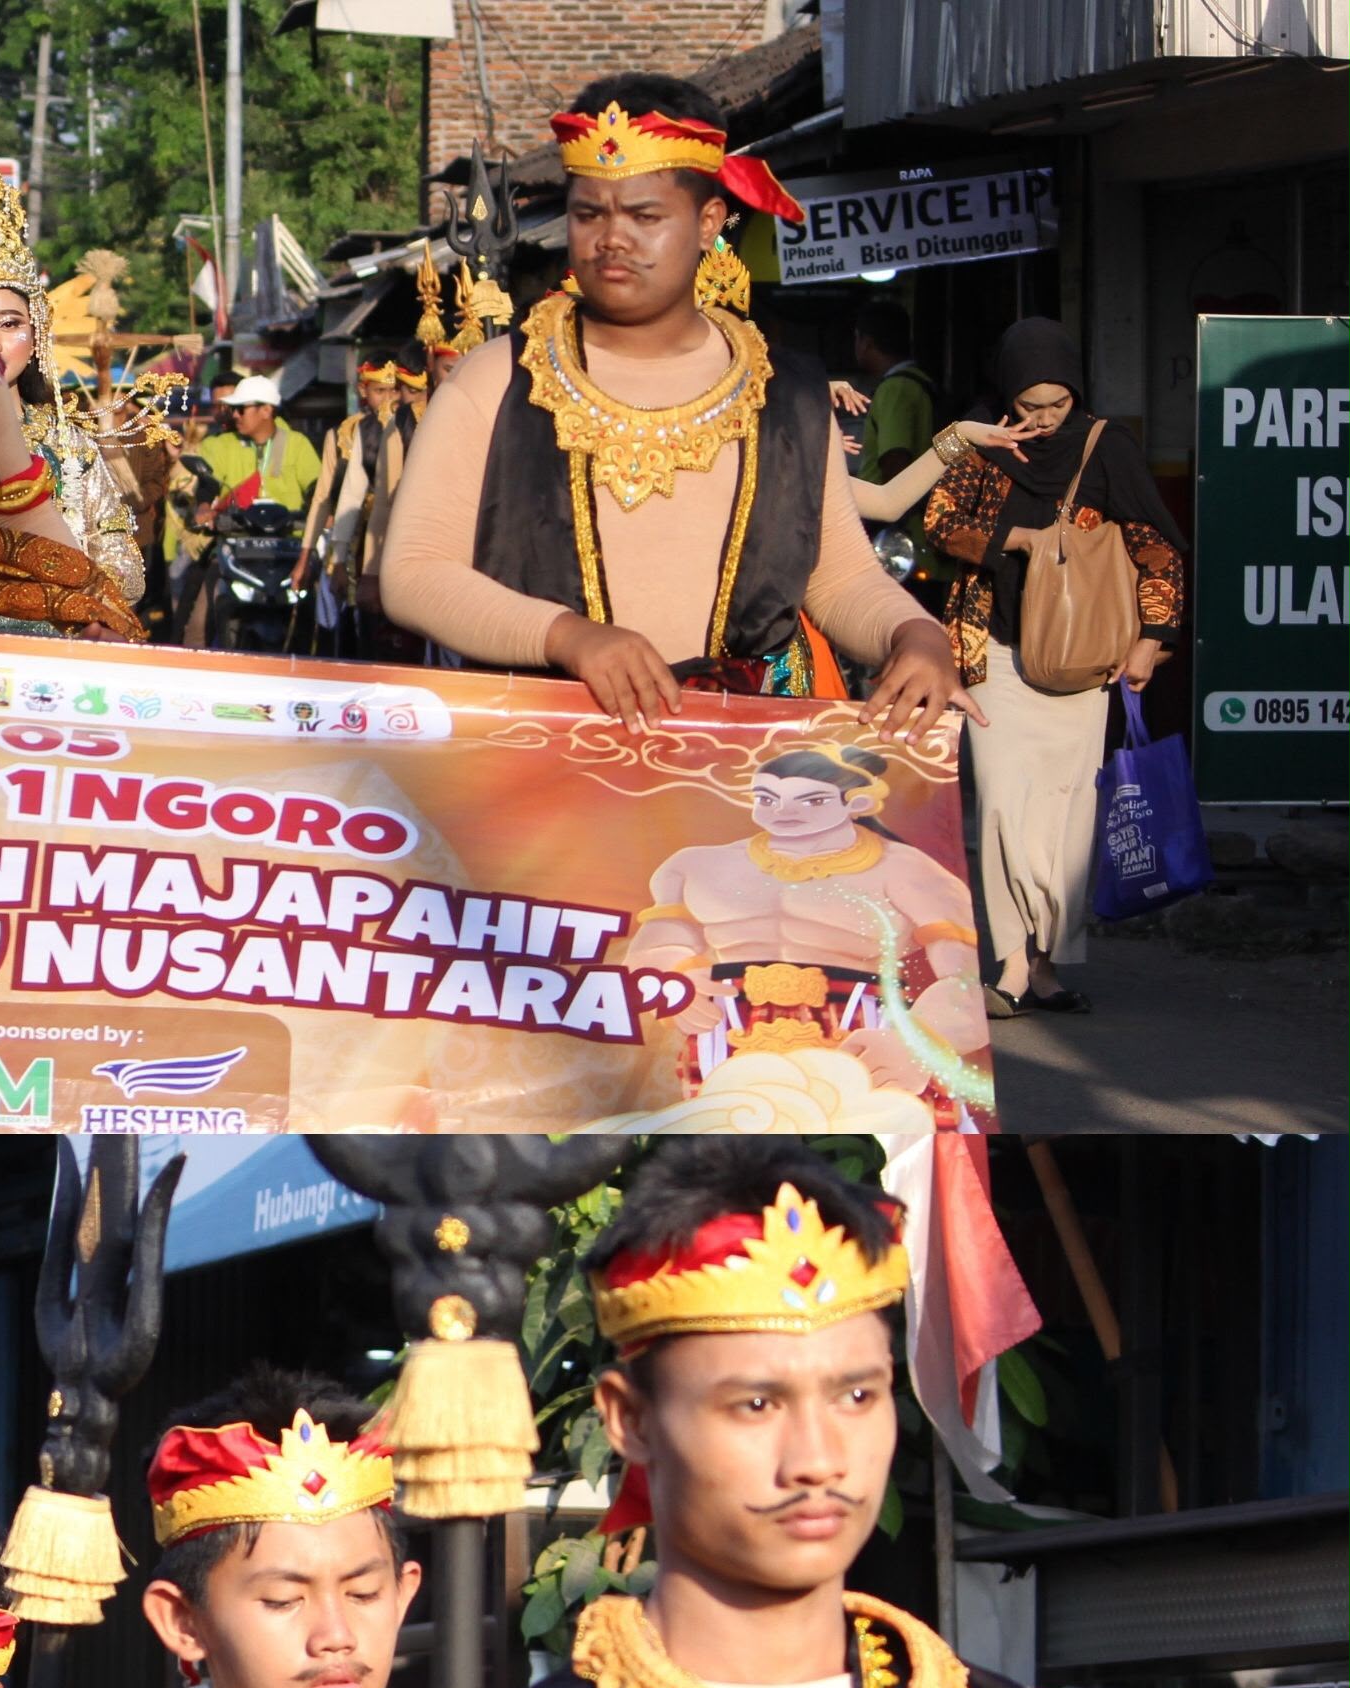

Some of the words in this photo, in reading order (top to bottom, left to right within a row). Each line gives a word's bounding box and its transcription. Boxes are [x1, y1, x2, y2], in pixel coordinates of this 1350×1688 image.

[781, 183, 973, 246] SERVICE
[785, 257, 845, 280] Android
[860, 243, 910, 266] Bisa
[915, 228, 1024, 259] Ditunggu
[1296, 476, 1350, 537] IS
[1253, 698, 1310, 724] 0895
[4, 766, 49, 818] 1
[67, 770, 412, 857] NGORO
[48, 849, 623, 961] MAJAPAHIT
[18, 918, 687, 1038] NUSANTARA”
[103, 1023, 134, 1048] by
[83, 1107, 245, 1134] HESHENG
[253, 1180, 338, 1233] Hubungi
